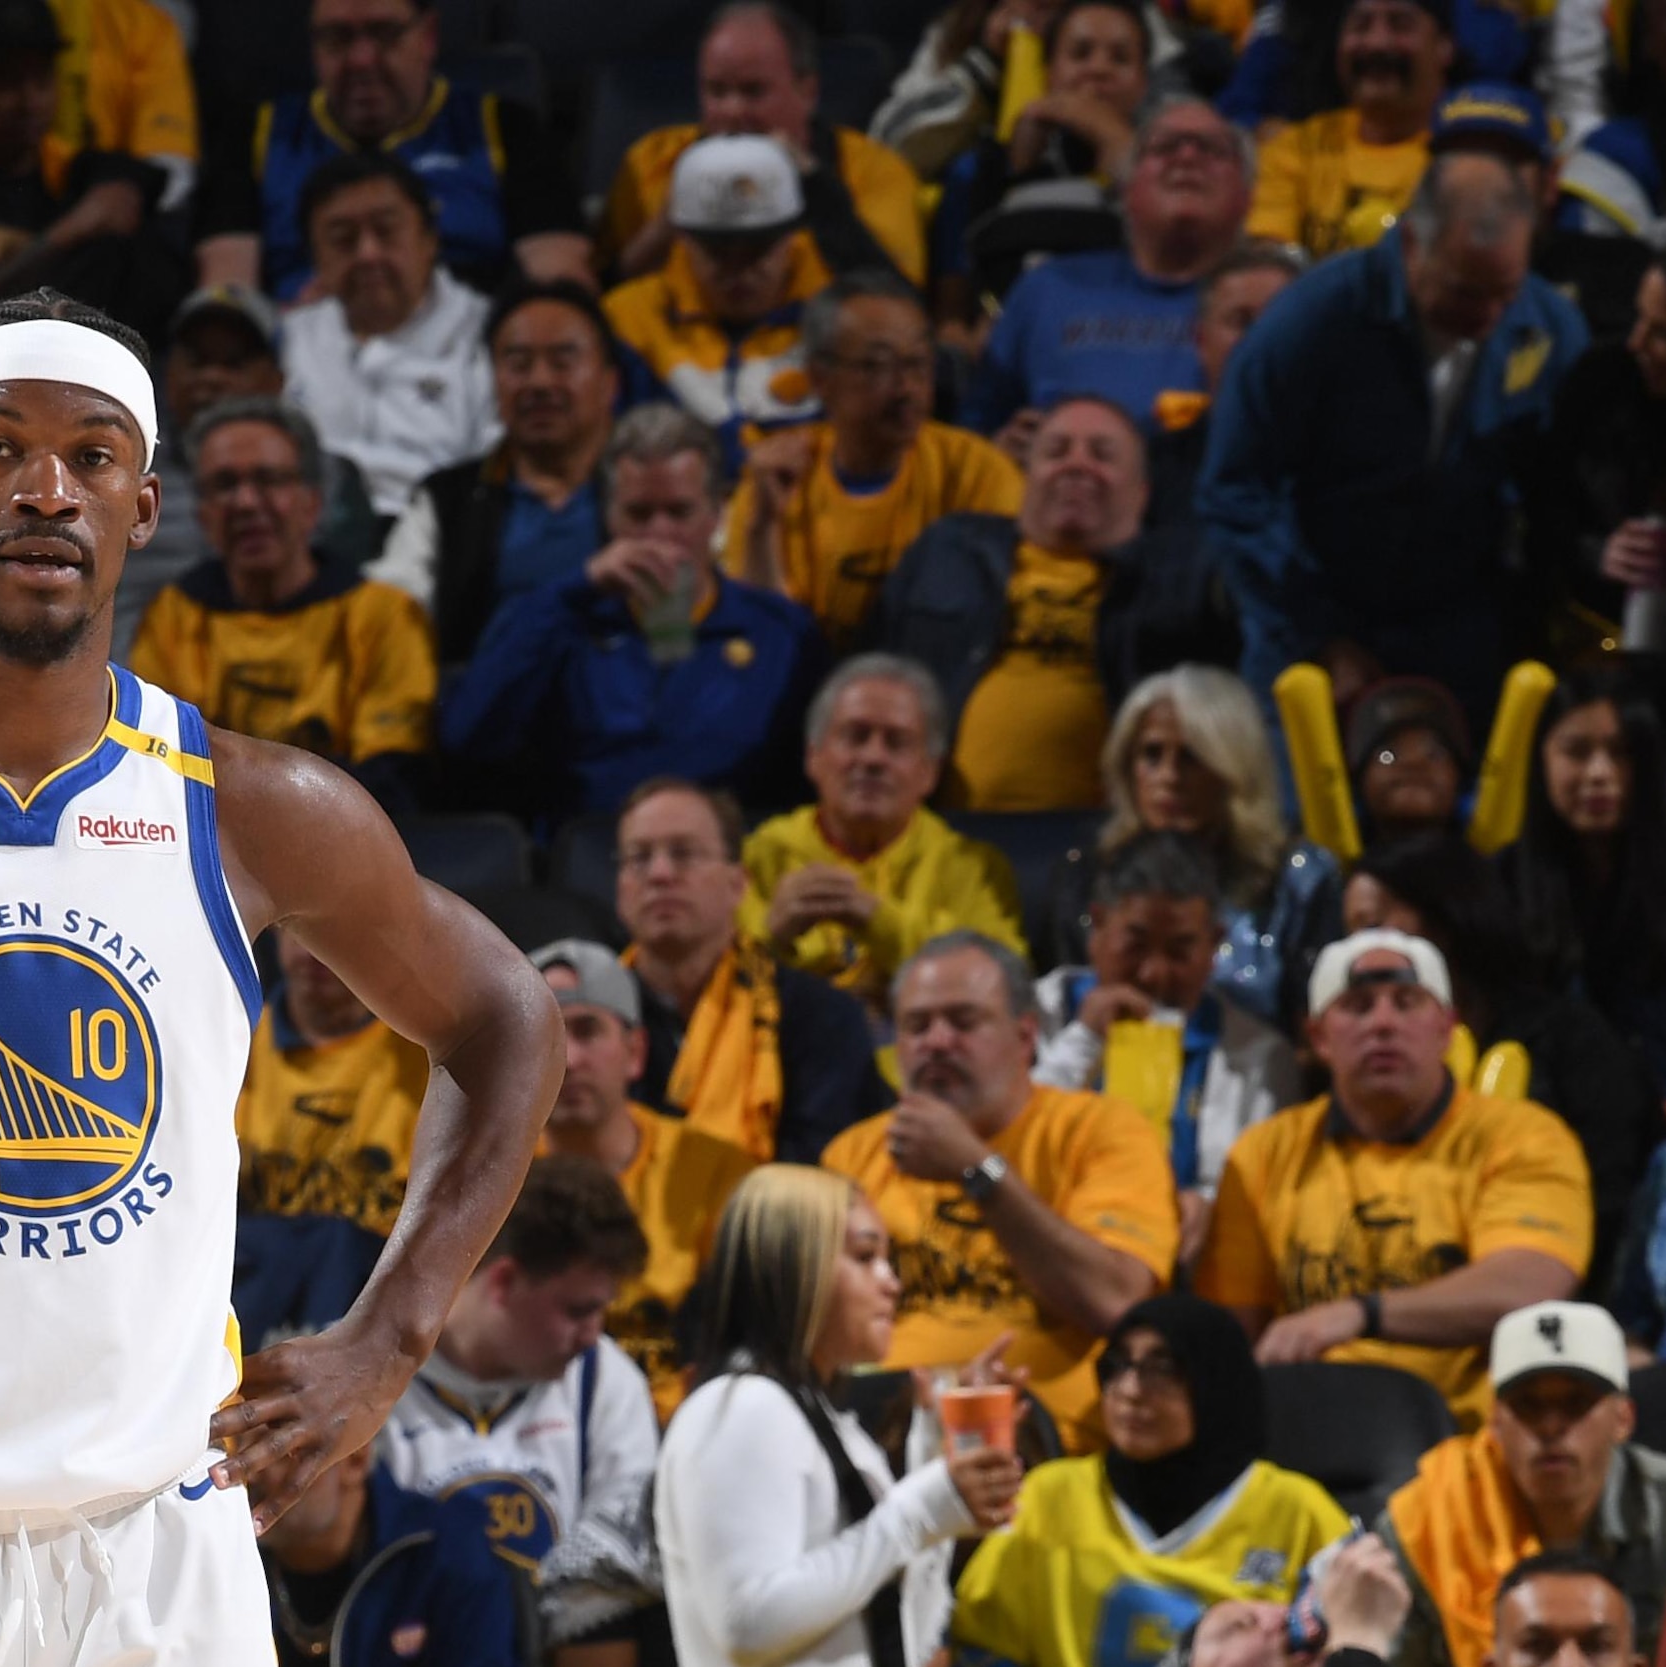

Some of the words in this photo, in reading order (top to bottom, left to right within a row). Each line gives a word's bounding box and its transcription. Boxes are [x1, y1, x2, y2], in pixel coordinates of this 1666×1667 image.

[145, 737, 168, 758] 16
[77, 814, 176, 845] Rakuten
[62, 909, 162, 994] STATE
[70, 1008, 127, 1081] 10
[485, 1492, 536, 1539] 30
